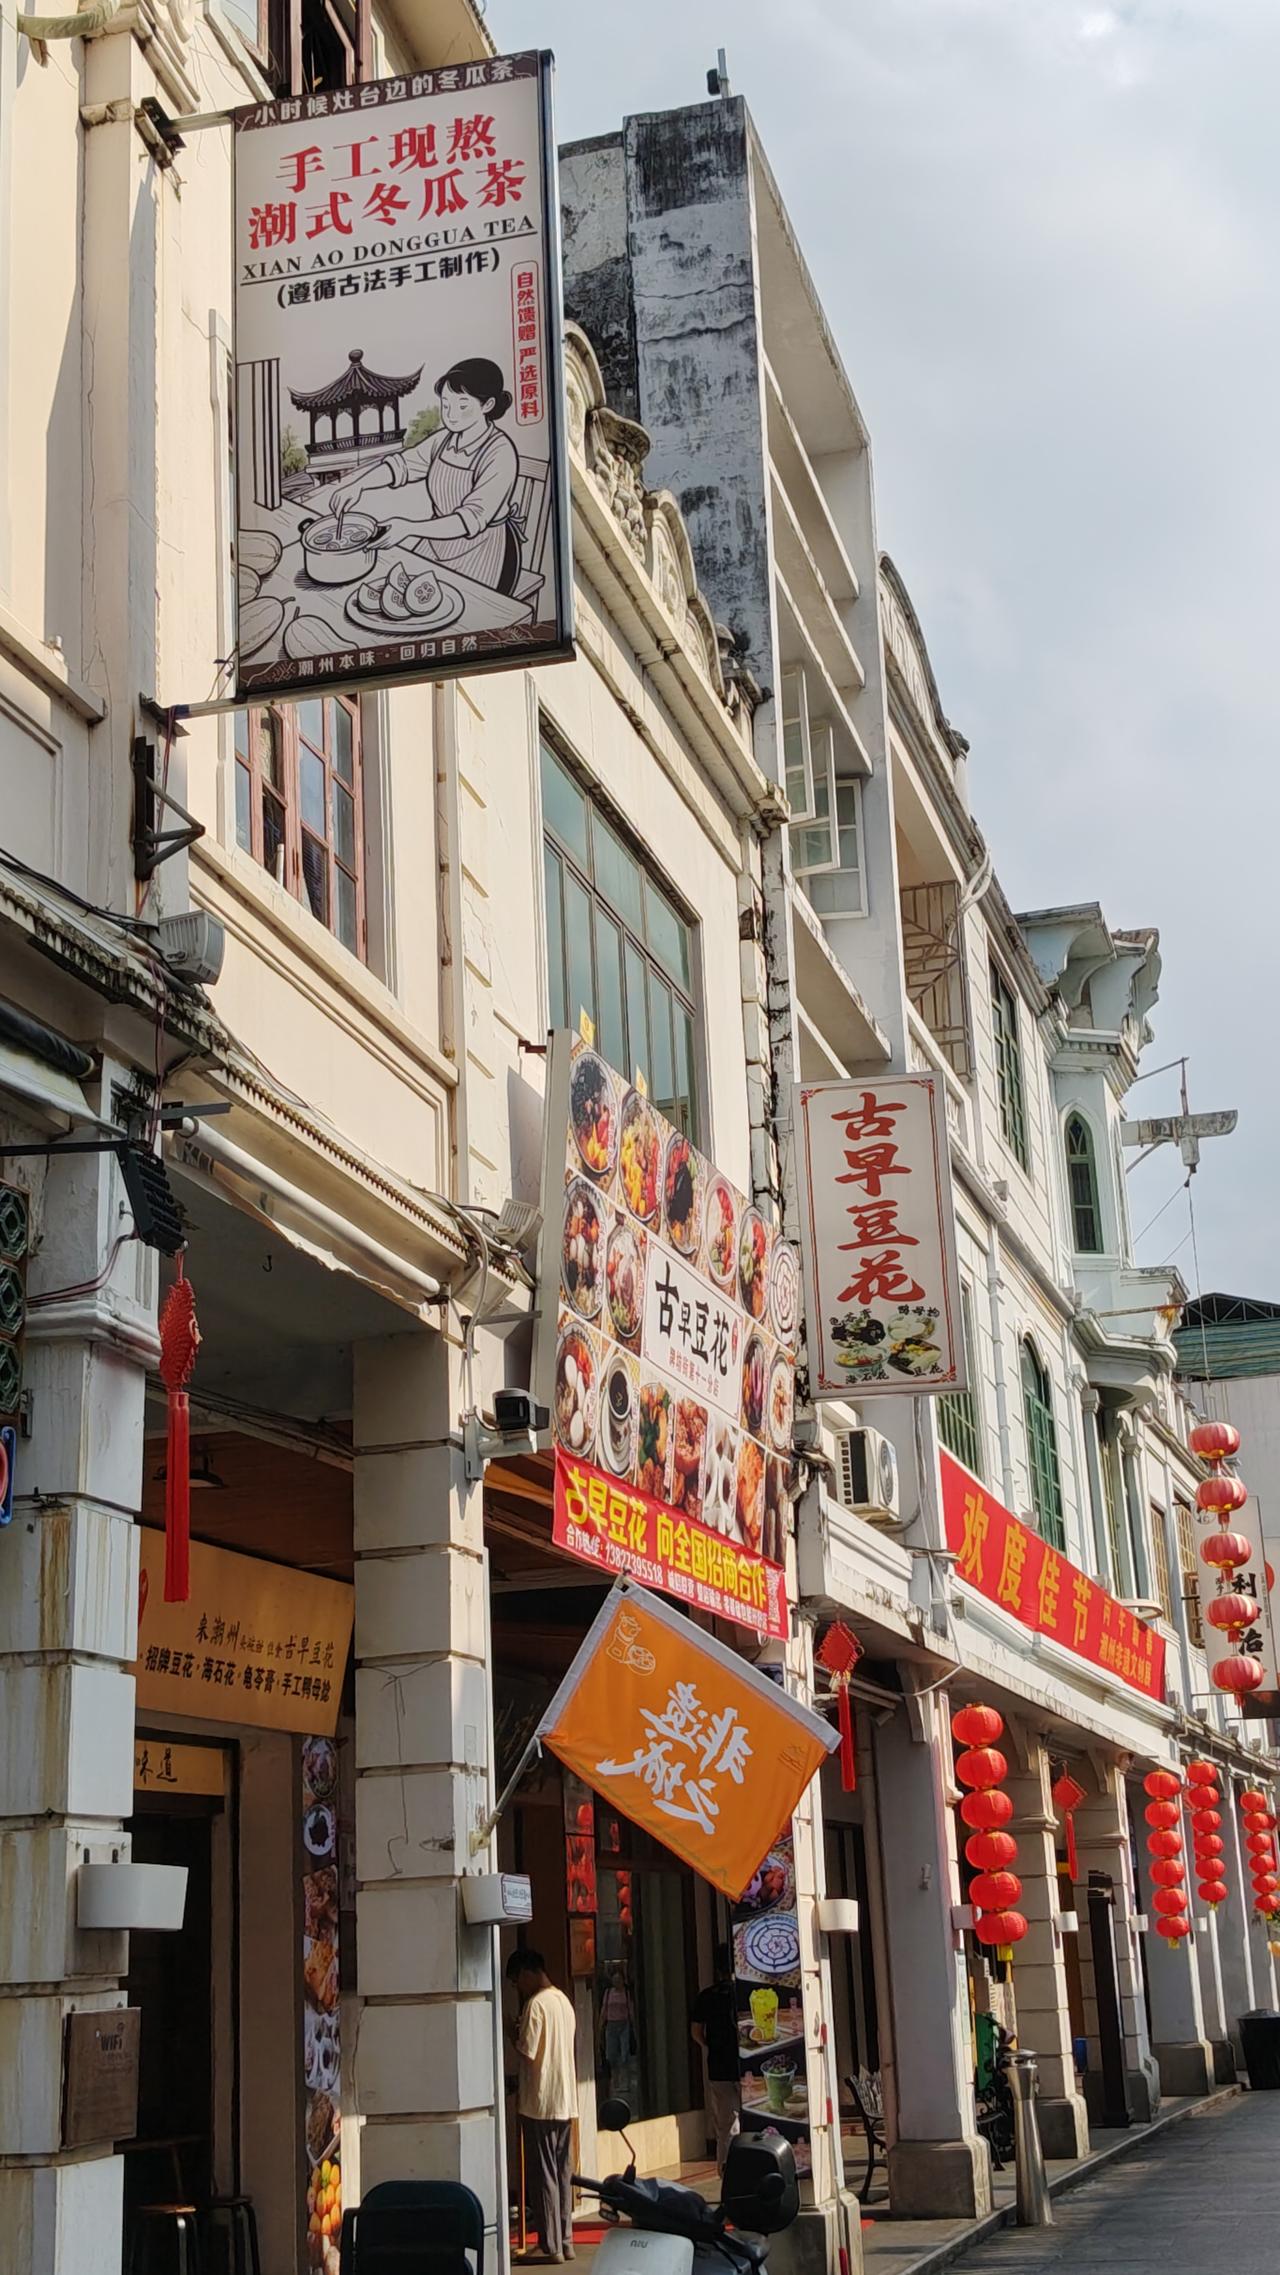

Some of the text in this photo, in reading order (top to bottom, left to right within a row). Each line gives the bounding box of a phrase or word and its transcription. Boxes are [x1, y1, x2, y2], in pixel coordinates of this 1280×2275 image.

[253, 58, 516, 126] 小时候灶台边的冬瓜茶
[248, 159, 528, 251] 潮式冬瓜茶
[275, 113, 498, 194] 手工现熬
[241, 214, 536, 281] XIAN AO DONGGUA TEA
[831, 1091, 926, 1305] 古早豆花
[654, 1260, 729, 1377] 古早豆花
[565, 1465, 648, 1554] 古早豆花
[656, 1511, 768, 1610] 向全国招商合作
[957, 1492, 1093, 1648] 欢度佳节
